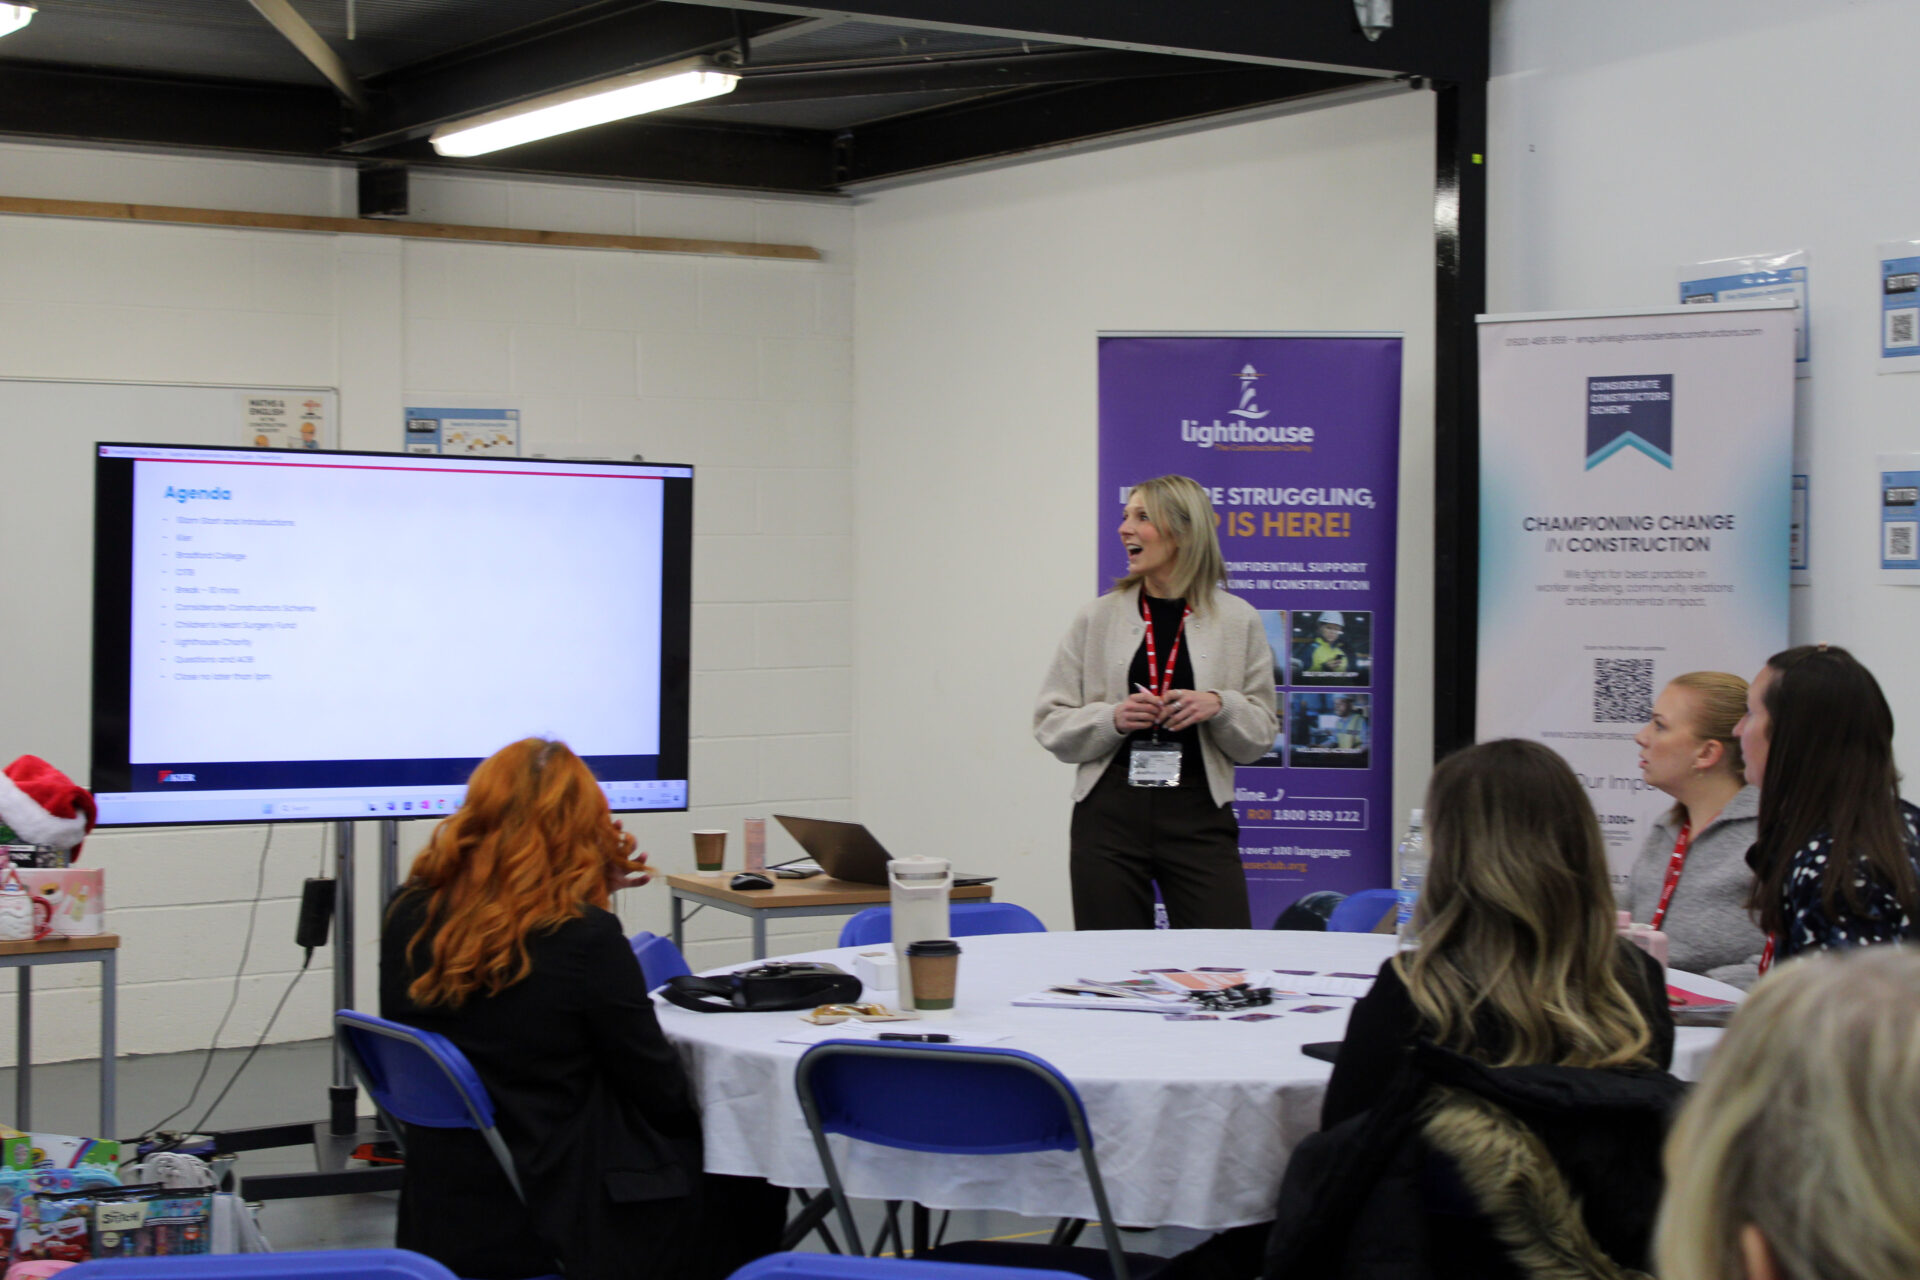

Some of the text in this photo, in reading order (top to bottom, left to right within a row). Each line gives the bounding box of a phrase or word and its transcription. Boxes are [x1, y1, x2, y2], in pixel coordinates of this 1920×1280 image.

[1590, 379, 1661, 390] CONSIDERATE
[1590, 391, 1670, 403] CONSTRUCTORS
[1590, 405, 1631, 415] SCHEME
[1181, 420, 1314, 448] lighthouse
[164, 485, 232, 503] Agenda
[1227, 487, 1376, 508] STRUGGLING,
[1228, 512, 1256, 537] IS
[1262, 512, 1351, 537] HERE!
[1522, 514, 1736, 532] CHAMPIONING CHANGE
[1546, 537, 1711, 553] IN CONSTRUCTION
[1308, 562, 1368, 573] SUPPORT
[1583, 569, 1606, 581] fight
[1609, 569, 1622, 579] for
[1625, 569, 1649, 579] best
[1256, 580, 1271, 590] IN
[1272, 580, 1370, 591] CONSTRUCTION
[1565, 597, 1587, 606] and
[1247, 808, 1272, 820] ROI
[1274, 809, 1307, 821] 1800
[1335, 810, 1360, 822] 122
[1293, 845, 1352, 858] languages
